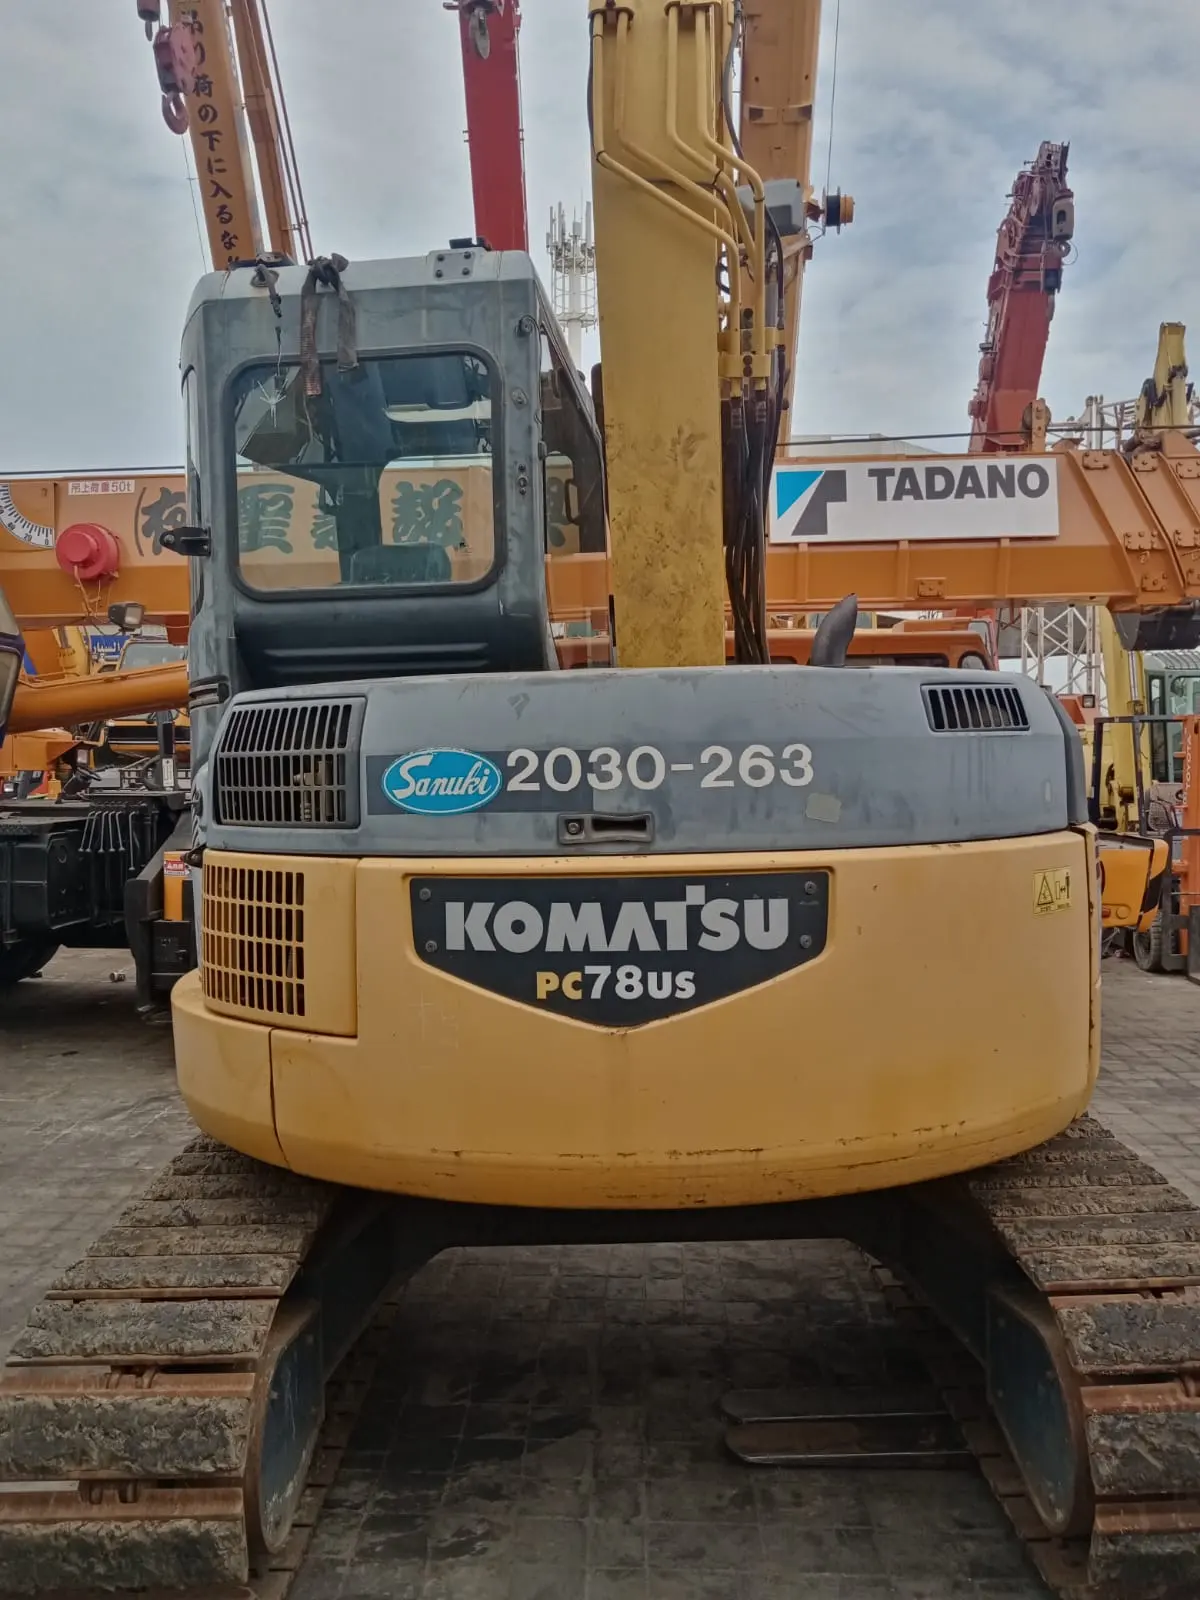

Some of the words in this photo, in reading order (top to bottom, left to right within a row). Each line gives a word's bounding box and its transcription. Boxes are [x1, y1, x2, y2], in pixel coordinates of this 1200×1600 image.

[868, 463, 1050, 502] TADANO
[392, 753, 492, 800] Sanuki
[506, 743, 815, 793] 2030-263
[444, 884, 789, 953] KOMATSU
[536, 964, 696, 1000] PC78US
